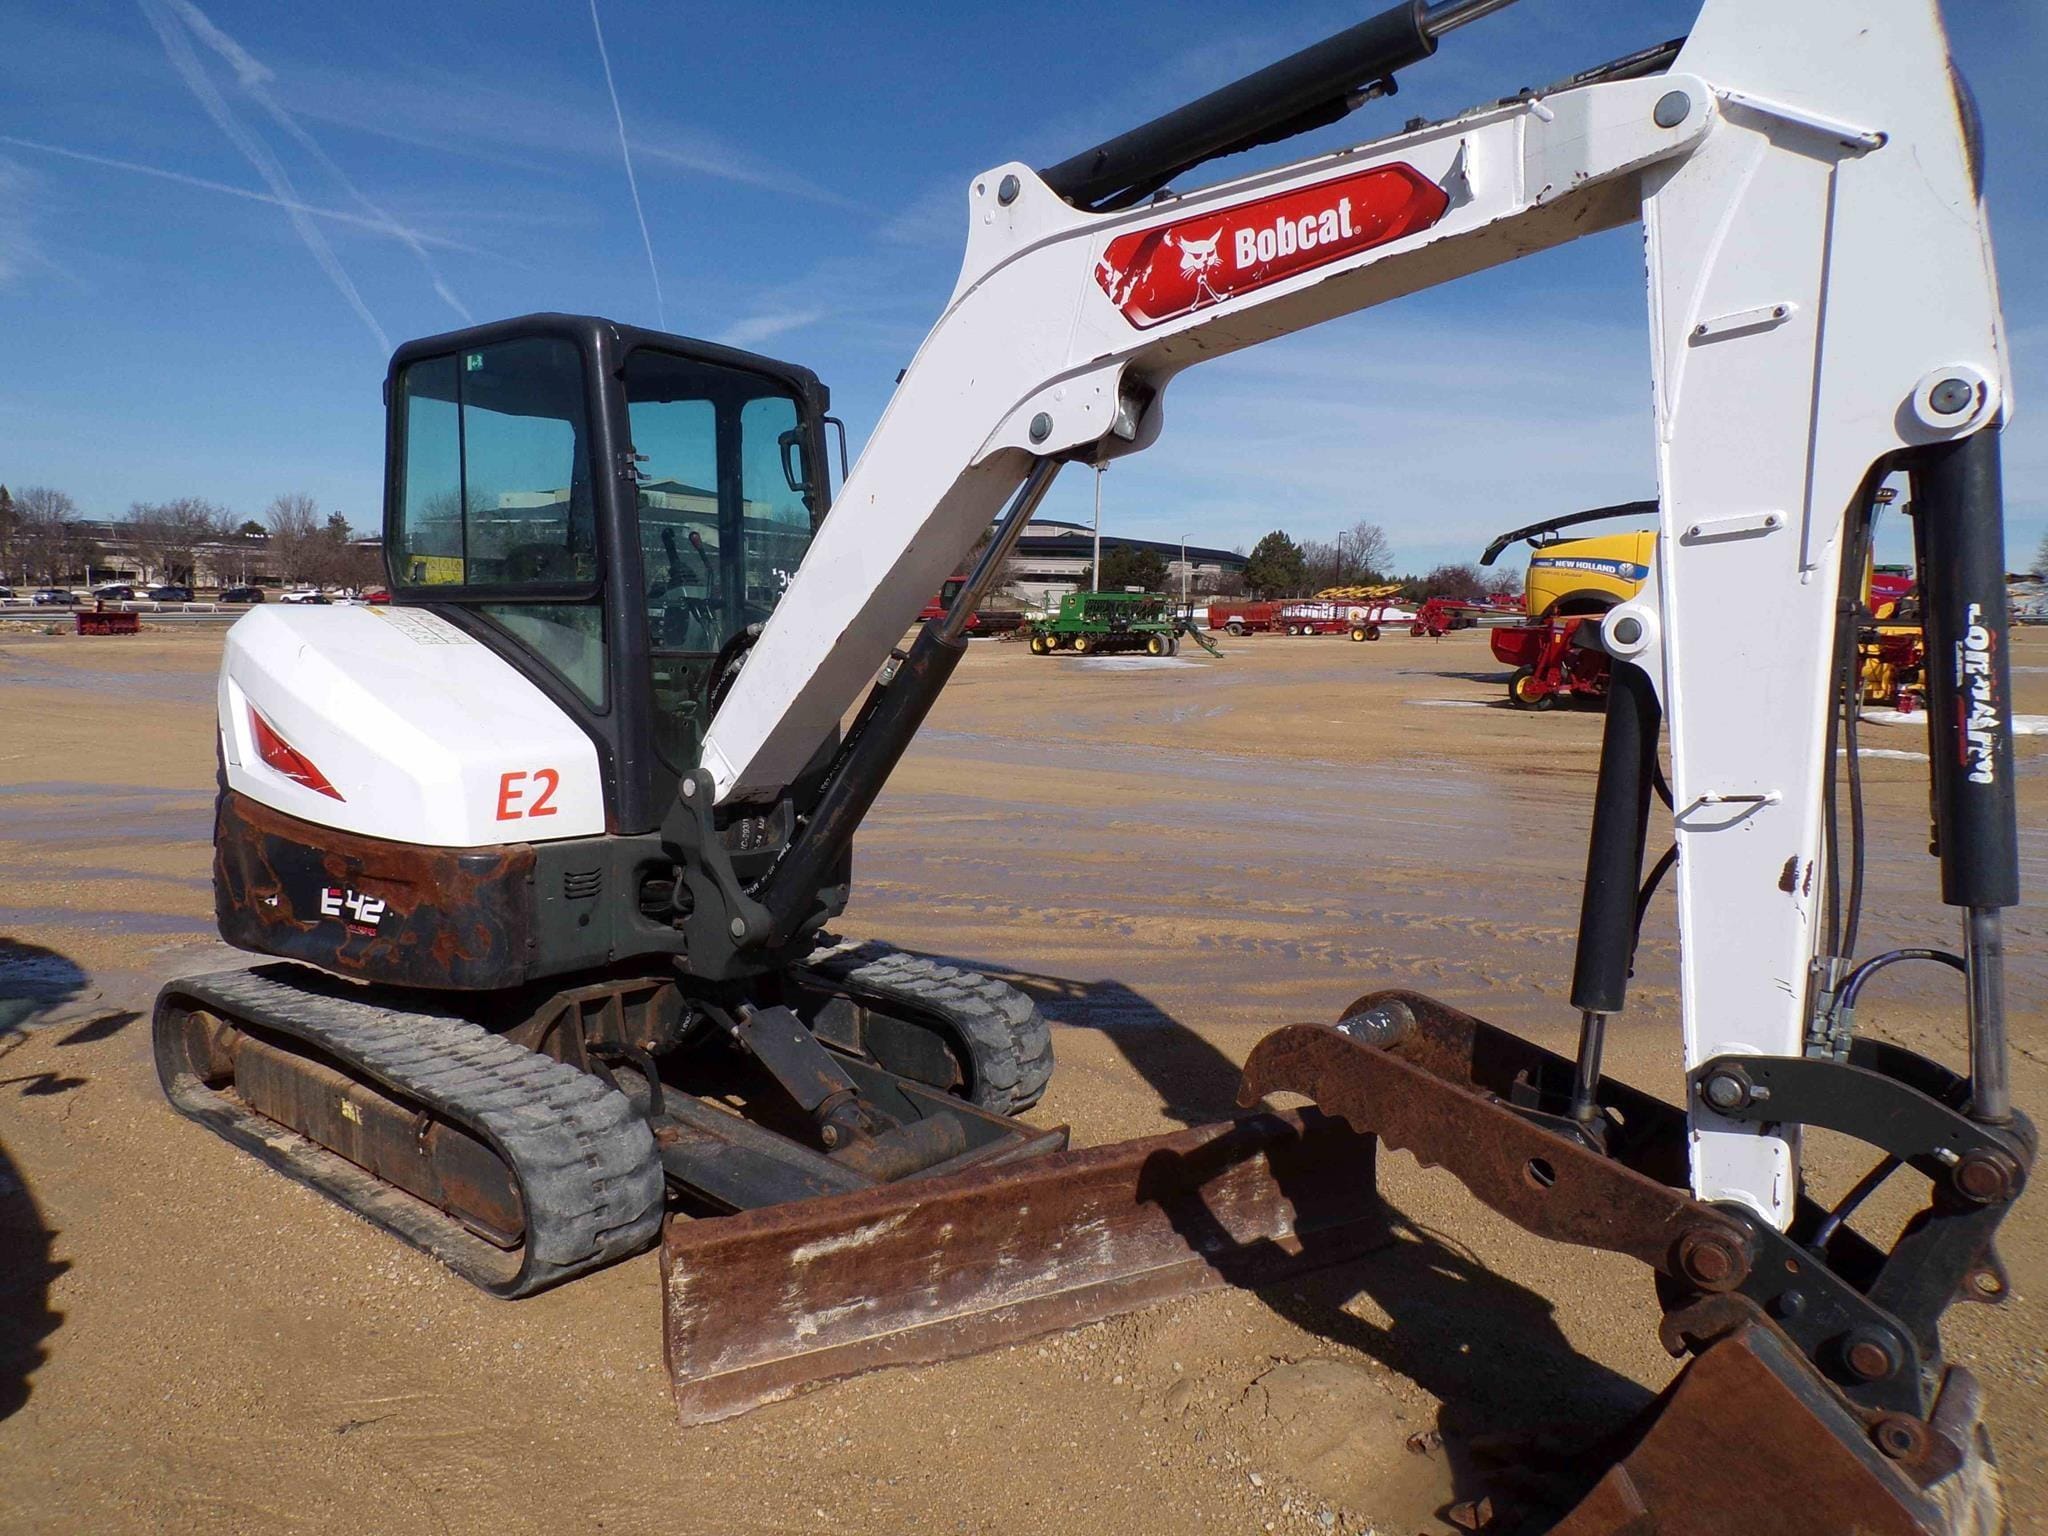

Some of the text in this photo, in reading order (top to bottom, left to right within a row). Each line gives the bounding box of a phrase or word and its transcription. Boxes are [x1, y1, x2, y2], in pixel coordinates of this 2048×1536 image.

[1235, 197, 1353, 269] Bobcat
[1555, 560, 1574, 568] NEW
[1576, 561, 1616, 573] HOLLAND
[496, 768, 559, 821] E2
[321, 887, 386, 925] E42
